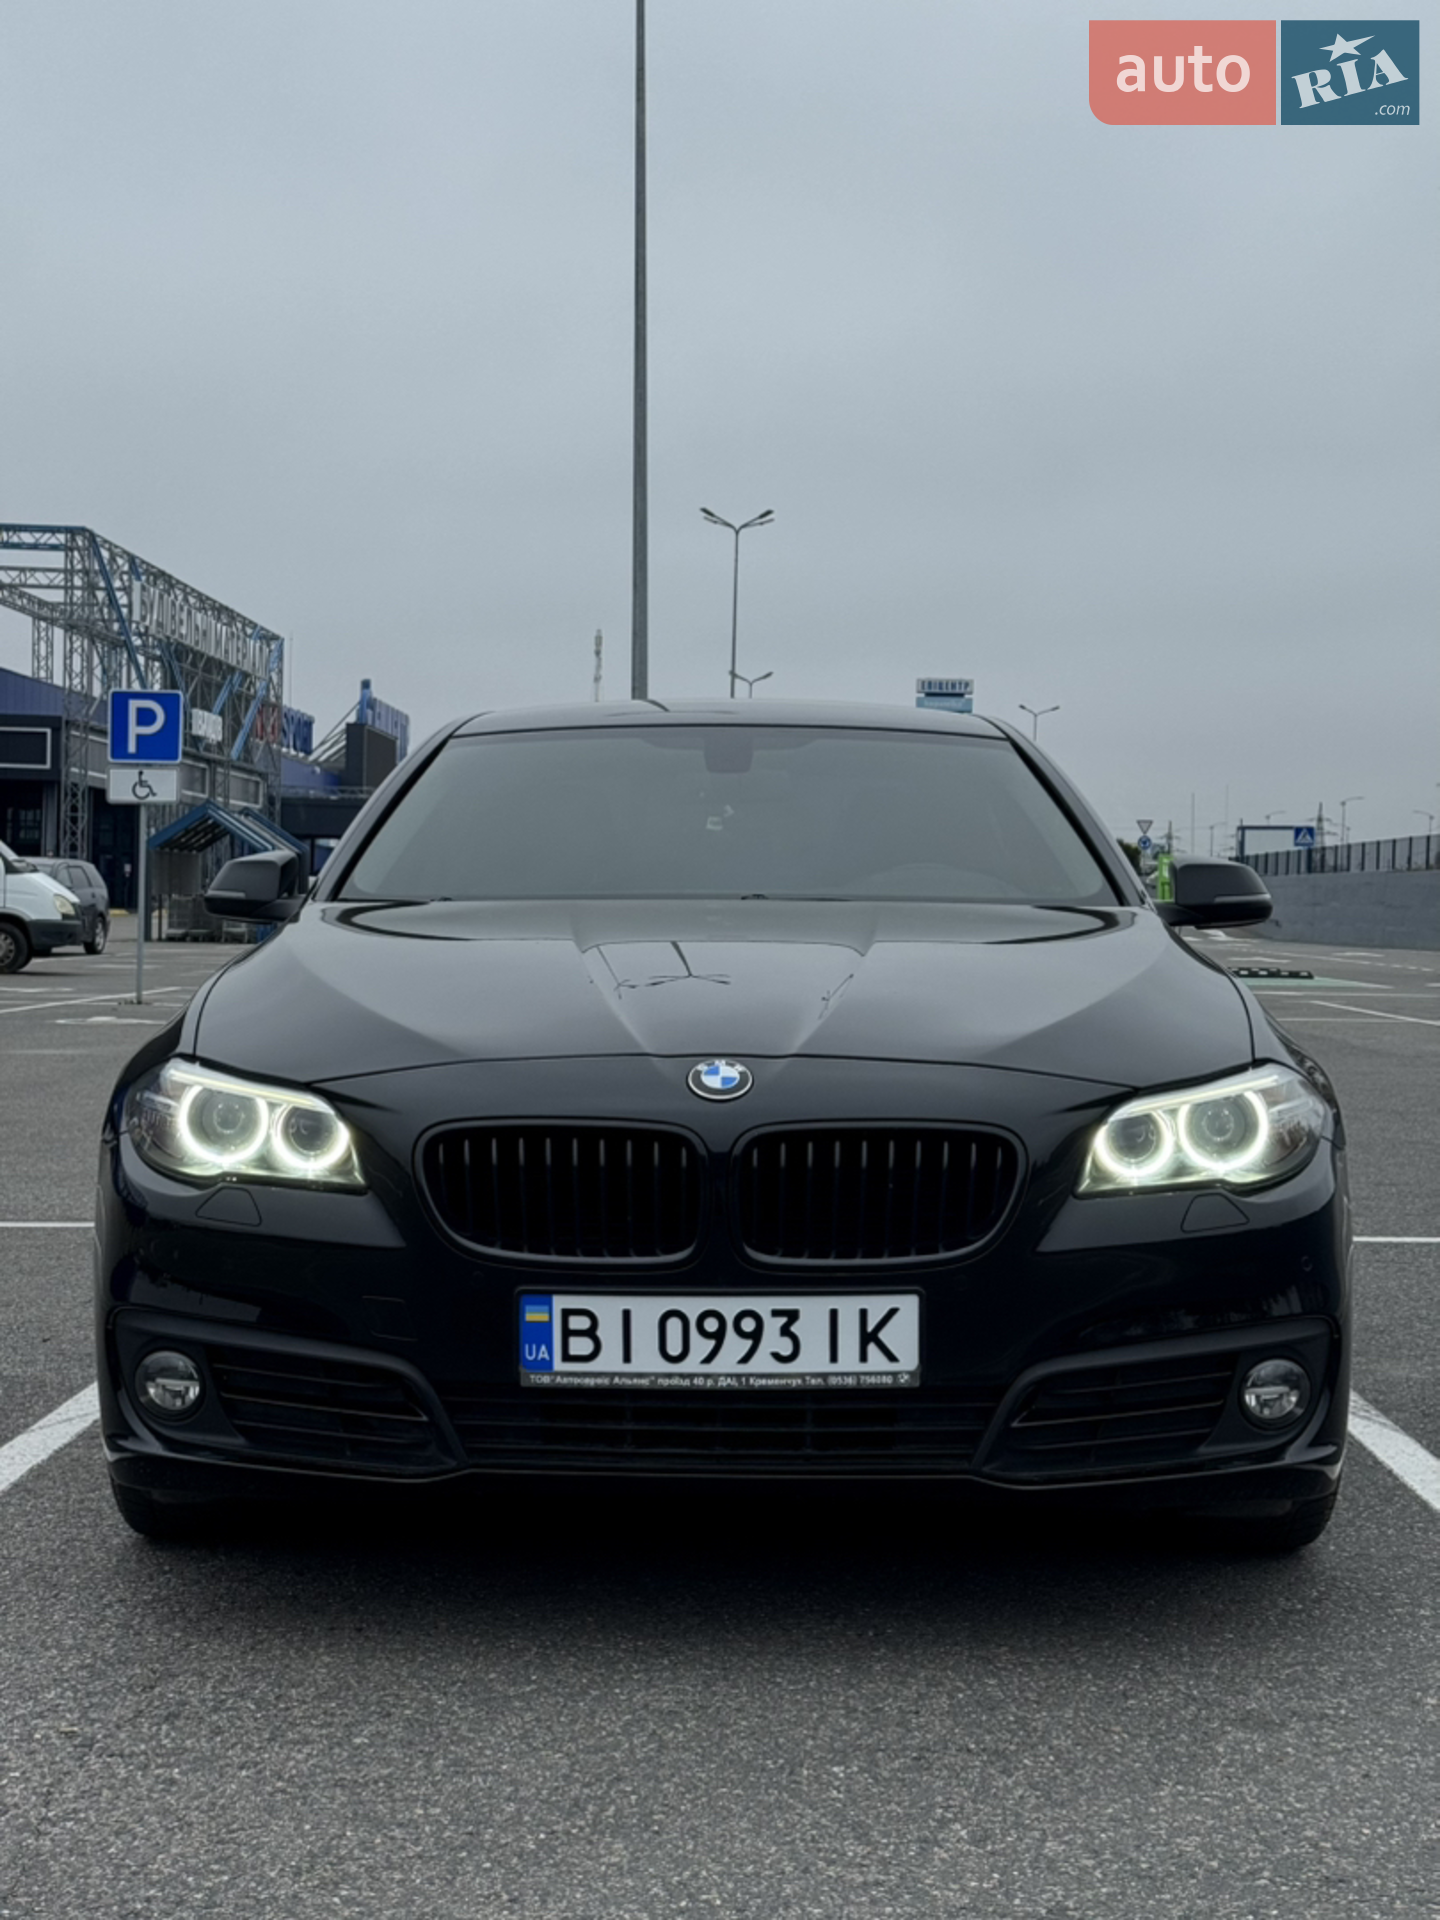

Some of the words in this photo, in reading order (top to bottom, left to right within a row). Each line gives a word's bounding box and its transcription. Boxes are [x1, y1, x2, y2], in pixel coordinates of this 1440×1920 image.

[127, 699, 165, 754] P
[525, 1343, 550, 1361] UA
[560, 1308, 633, 1364] BI
[657, 1308, 802, 1365] 0993
[829, 1307, 901, 1364] IK
